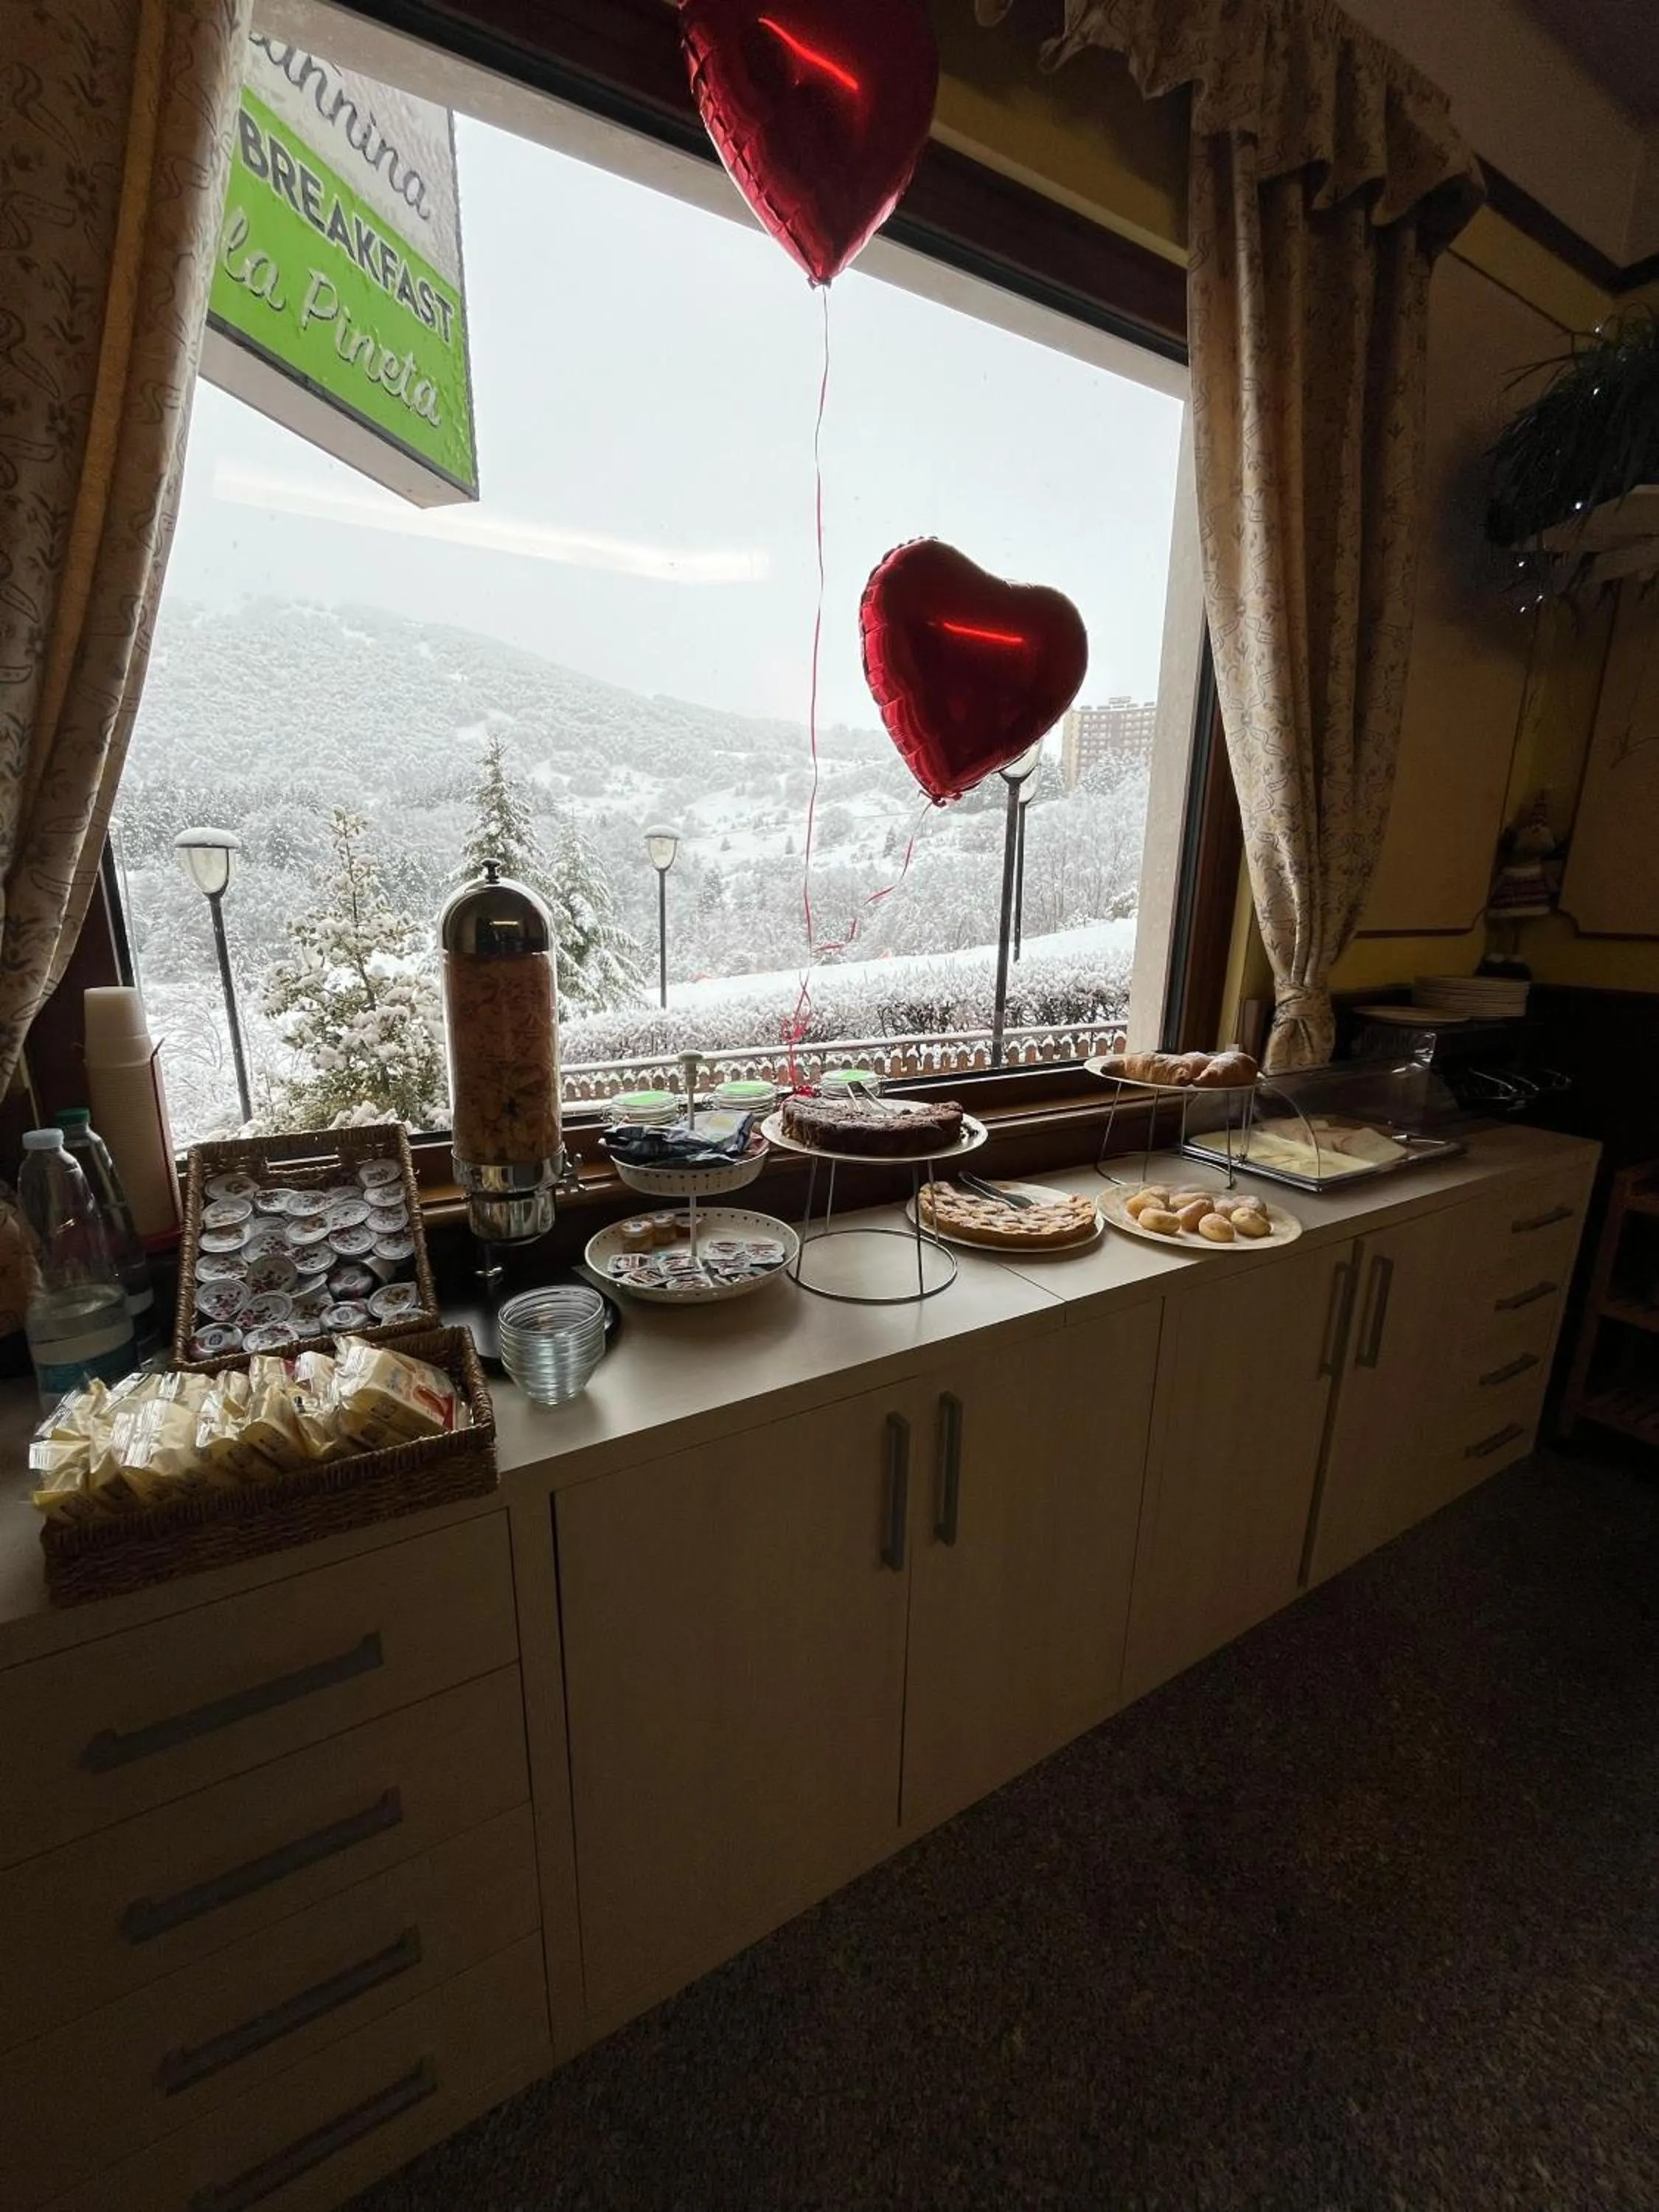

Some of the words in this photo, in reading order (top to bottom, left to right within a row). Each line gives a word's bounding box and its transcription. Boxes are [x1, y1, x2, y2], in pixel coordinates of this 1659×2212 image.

[248, 30, 431, 221] annina
[238, 107, 454, 345] BREAKFAST
[301, 268, 442, 428] Pineta
